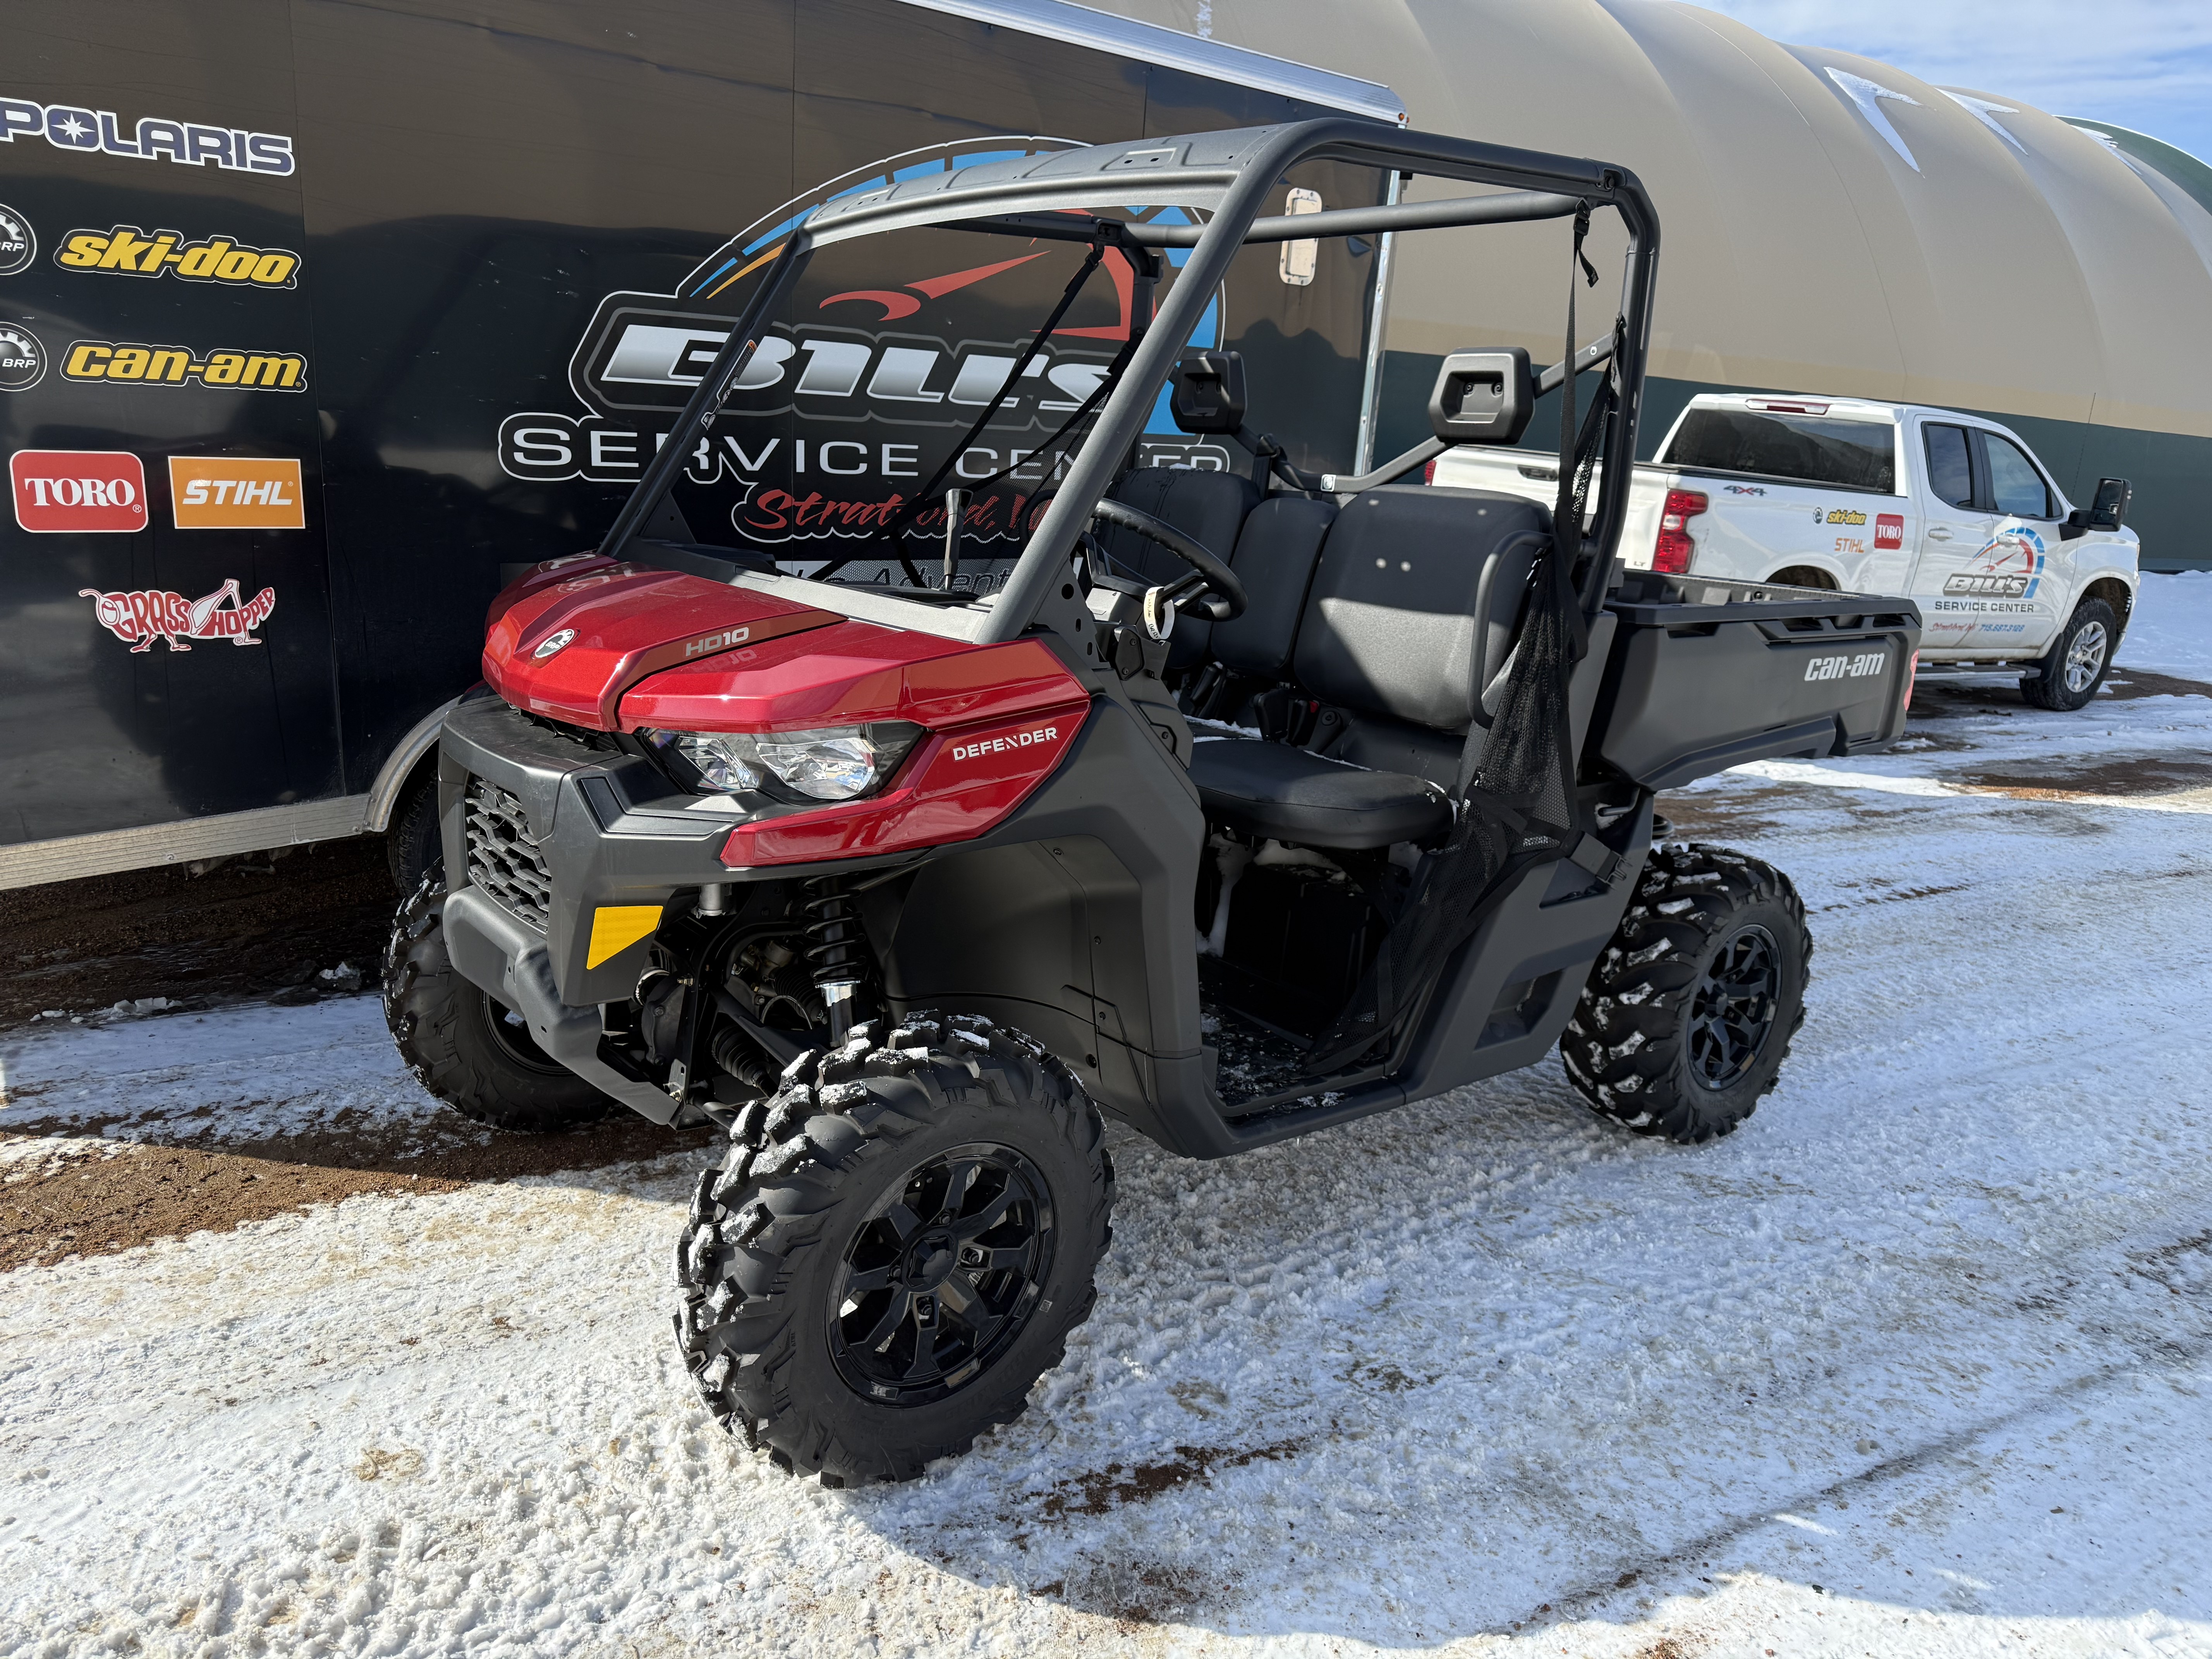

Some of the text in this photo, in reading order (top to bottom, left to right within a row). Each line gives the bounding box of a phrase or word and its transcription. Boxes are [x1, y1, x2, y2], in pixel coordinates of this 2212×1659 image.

[0, 98, 294, 175] POLARIS
[0, 241, 24, 252] RP
[2, 358, 36, 368] BRP
[24, 478, 293, 506] TORO STIHL
[1827, 511, 1901, 539] ski-doo TORO
[1834, 538, 1864, 553] STIHL
[1935, 601, 2034, 613] SERVICE CENTER
[545, 641, 560, 650] BRP
[685, 627, 749, 656] HD10
[1804, 653, 1885, 681] can-am
[953, 727, 1058, 761] DEFENDER
